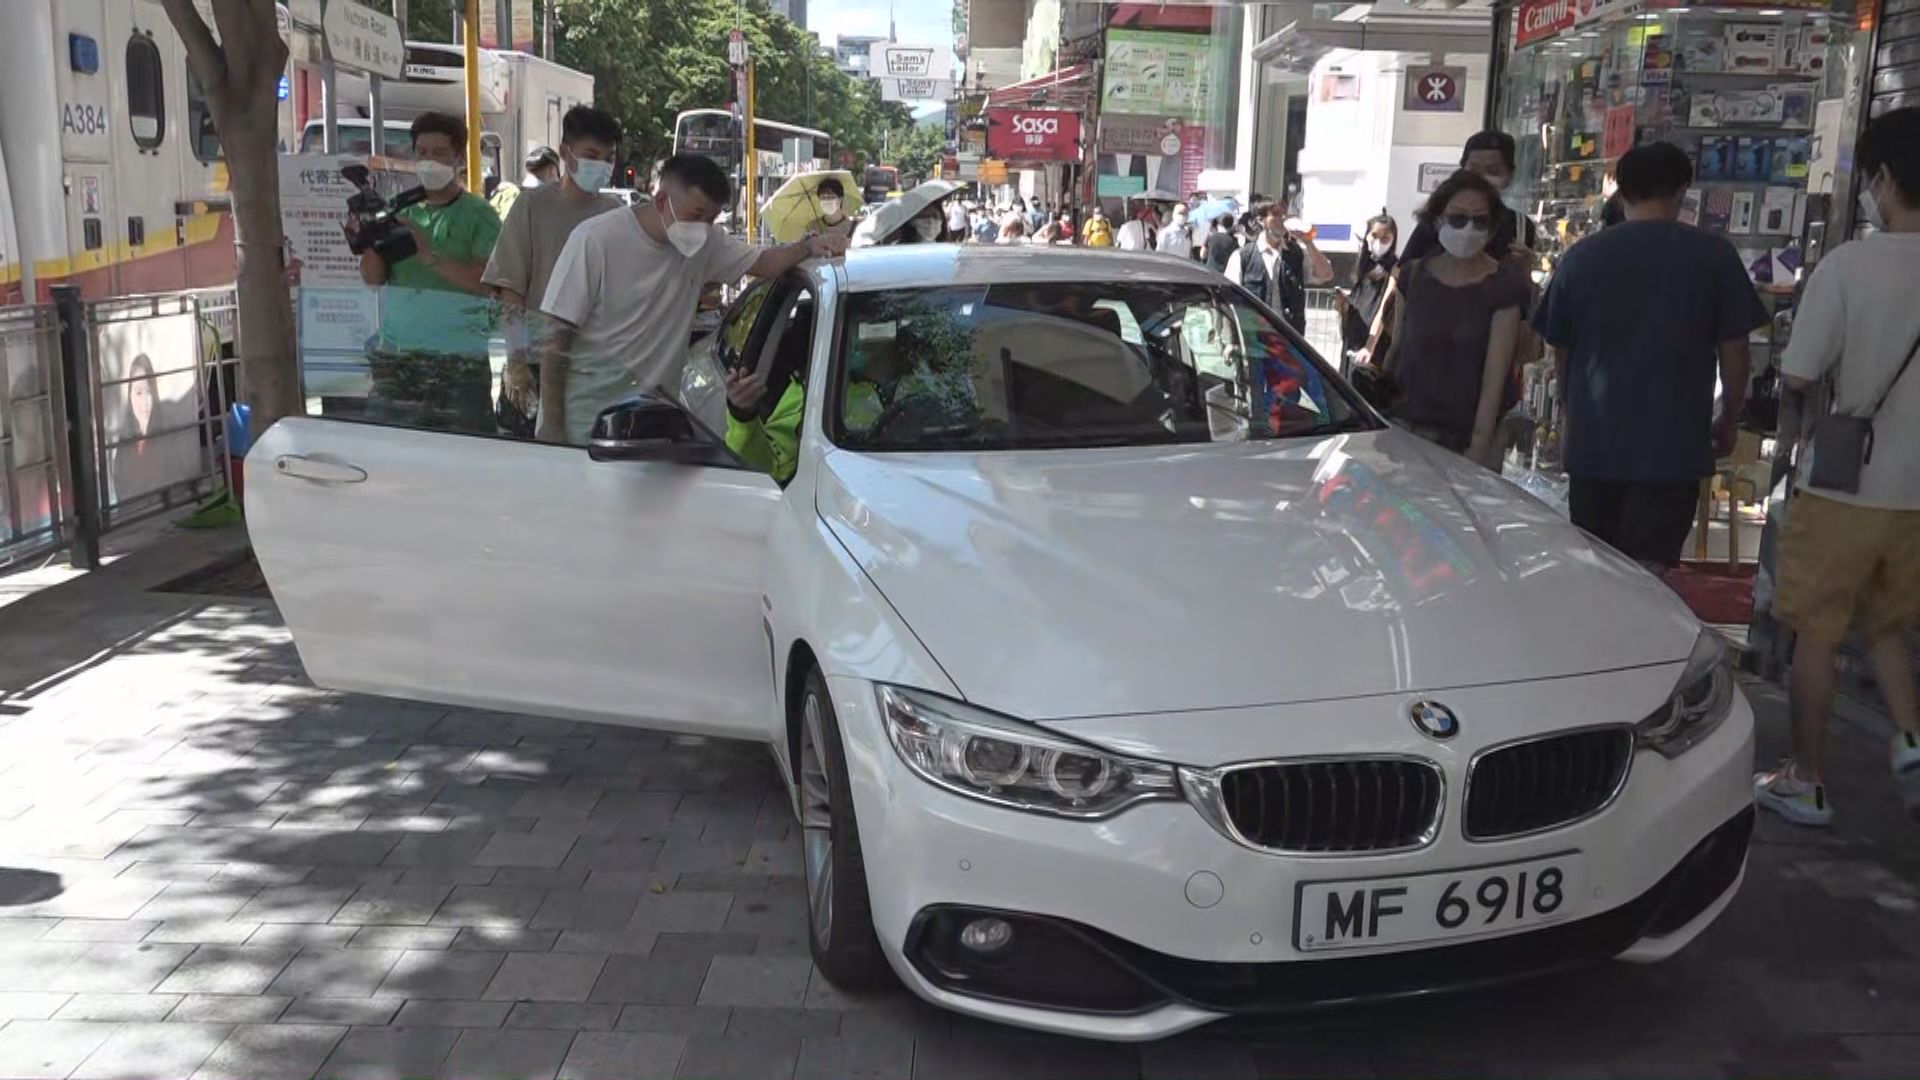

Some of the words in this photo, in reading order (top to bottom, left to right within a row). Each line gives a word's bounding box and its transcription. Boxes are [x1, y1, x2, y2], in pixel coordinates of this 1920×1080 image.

[370, 16, 387, 37] Road
[1525, 0, 1568, 33] Canon
[413, 65, 436, 75] KING
[896, 53, 925, 65] Sam's
[62, 103, 106, 135] A384
[1325, 886, 1408, 941] MF
[1436, 867, 1563, 929] 6918
